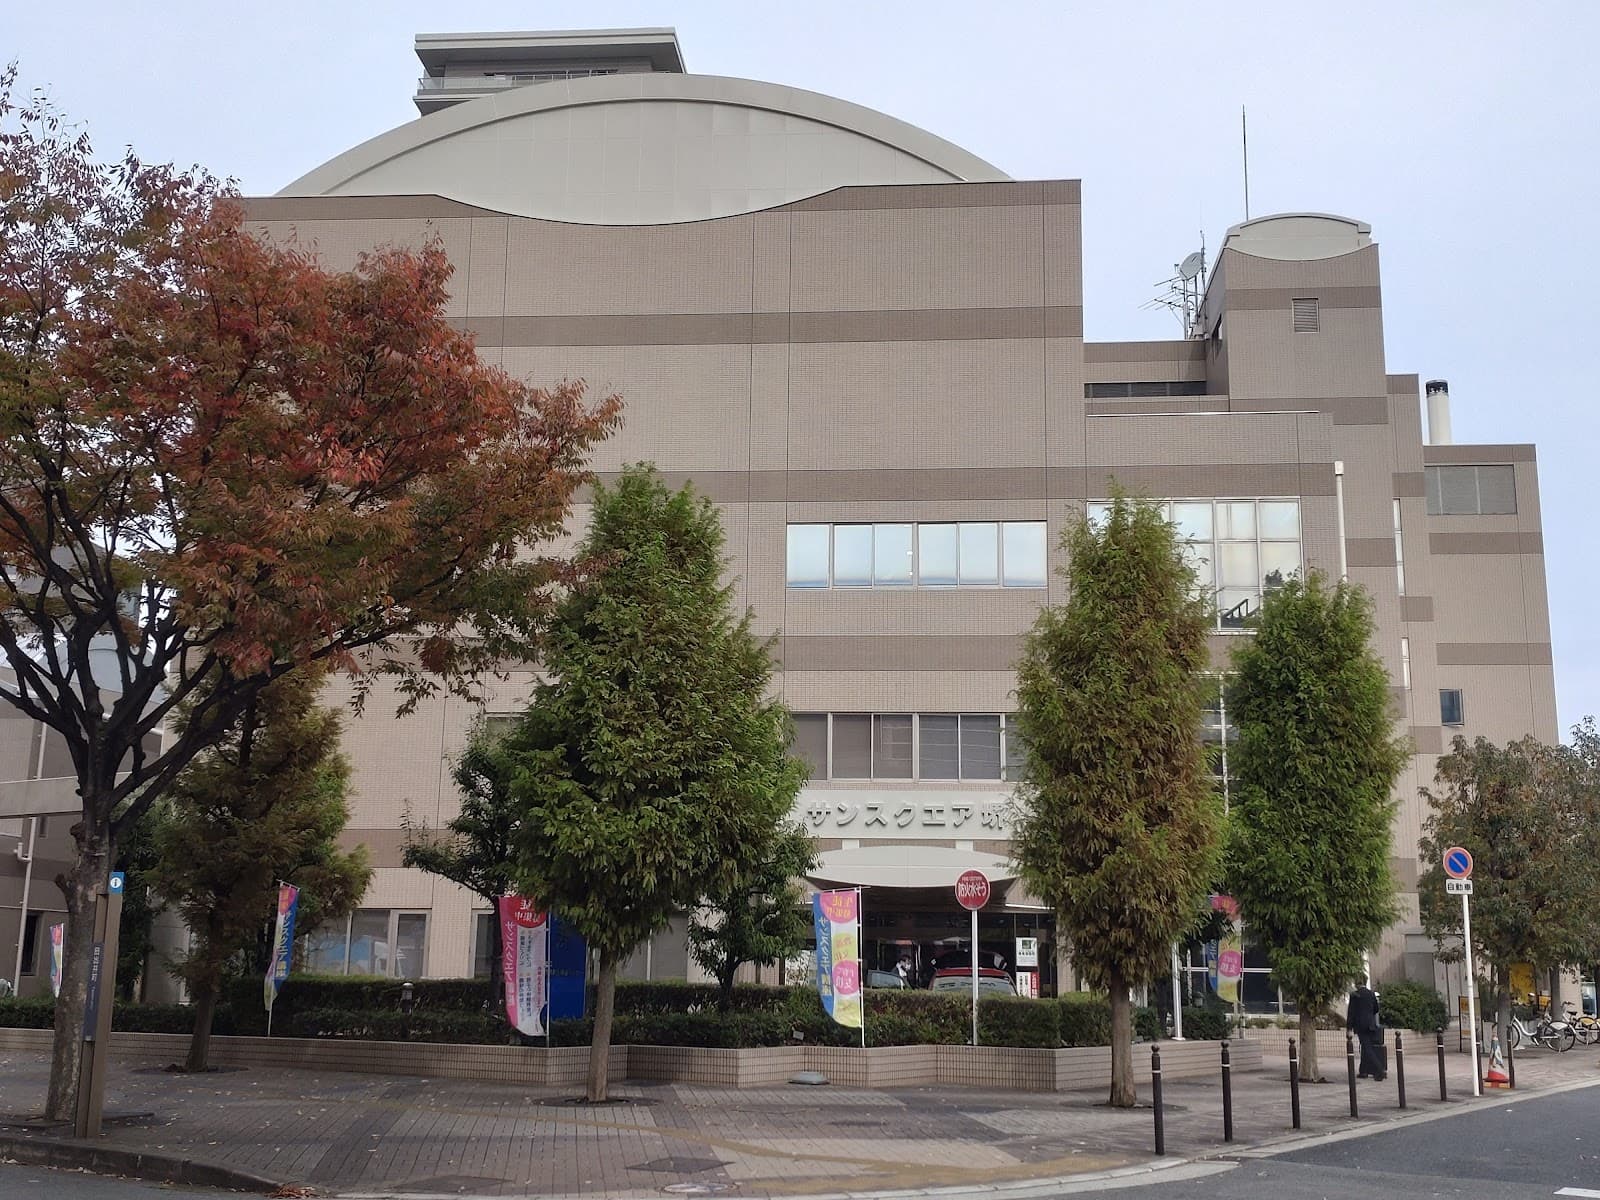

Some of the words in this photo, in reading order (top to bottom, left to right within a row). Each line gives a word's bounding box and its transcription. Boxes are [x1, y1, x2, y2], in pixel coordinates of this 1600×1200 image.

[958, 882, 987, 898] 防火水そう
[1447, 883, 1471, 891] 自動車
